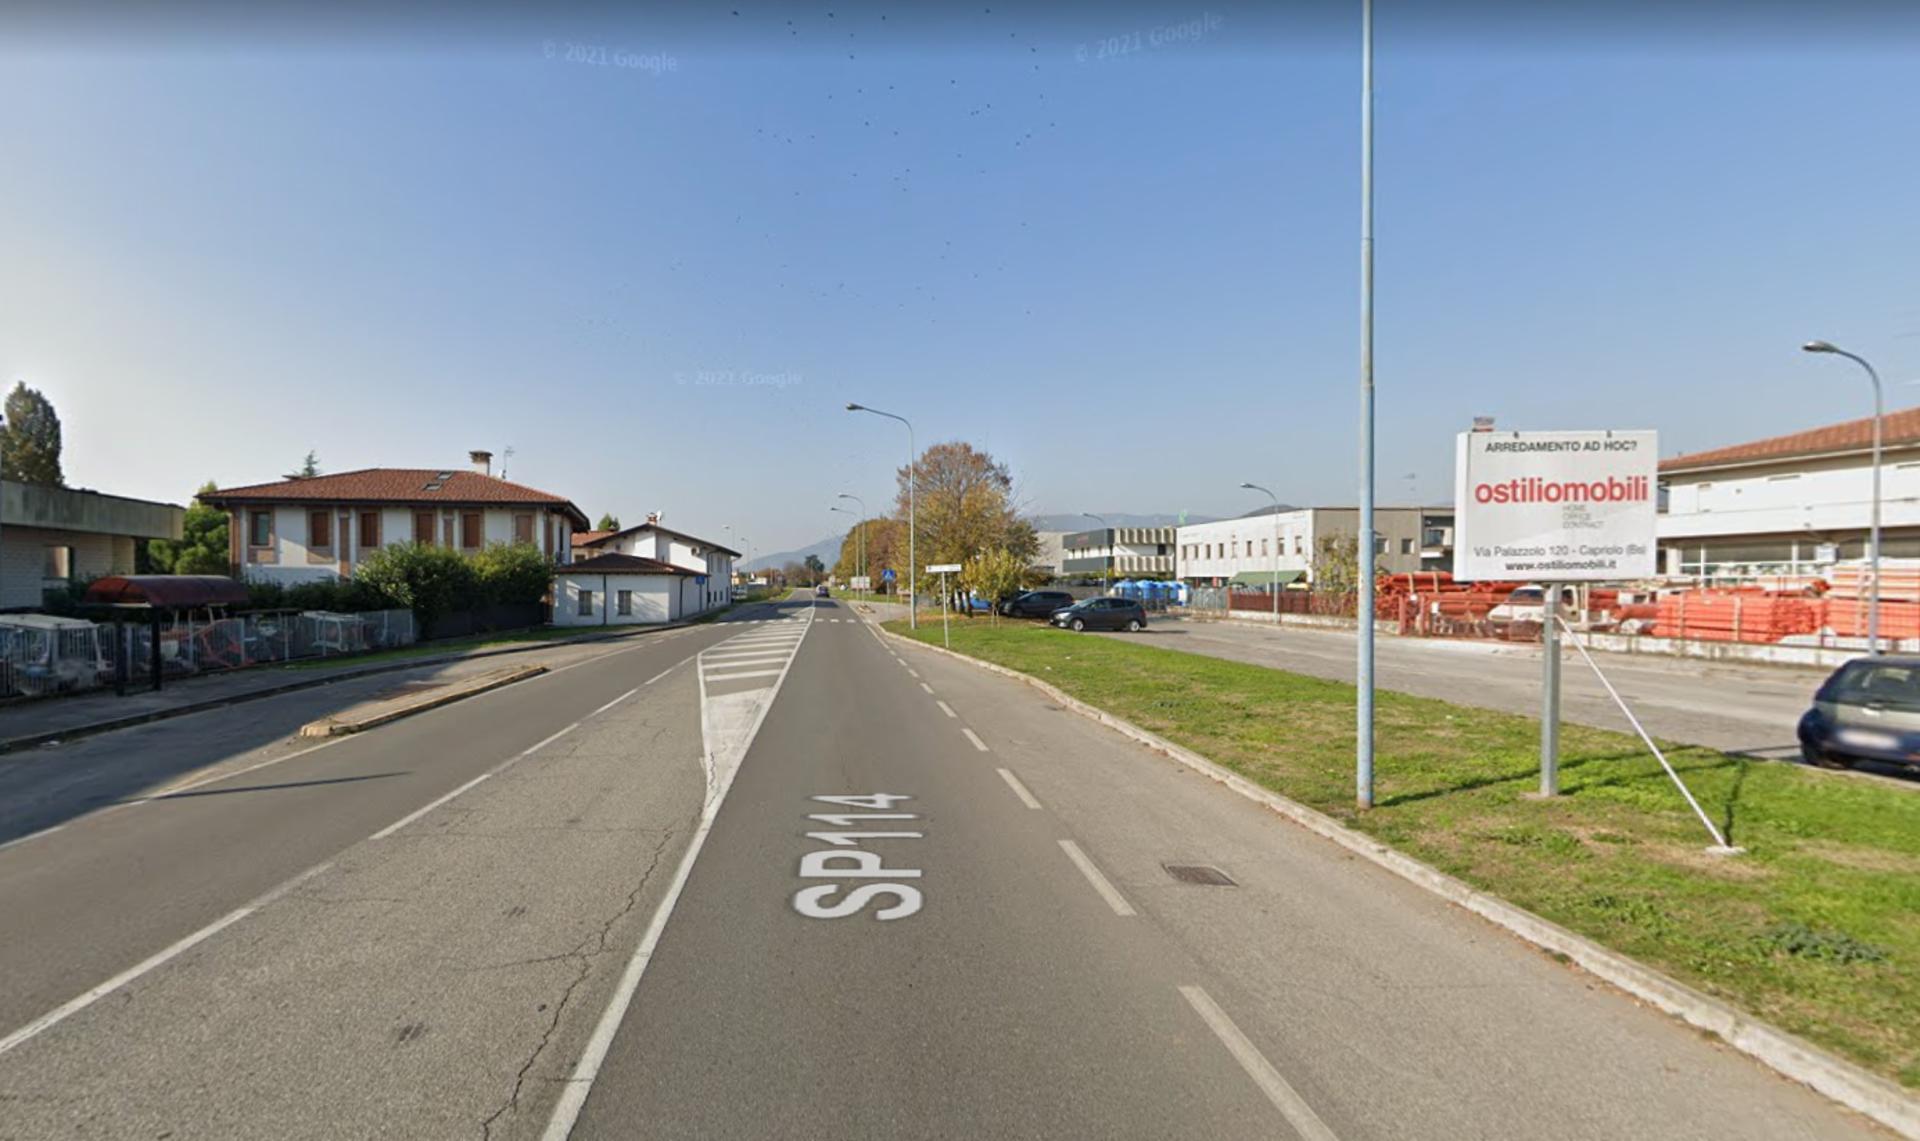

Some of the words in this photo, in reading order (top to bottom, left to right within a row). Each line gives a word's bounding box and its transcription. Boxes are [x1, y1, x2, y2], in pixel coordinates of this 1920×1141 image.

[1485, 441, 1580, 453] ARREDAMENTO
[1583, 441, 1600, 451] AD
[1604, 440, 1637, 450] HOC?
[1474, 475, 1649, 504] ostiliomobili
[1474, 547, 1491, 557] Via
[1494, 546, 1546, 557] Palazzolo
[1549, 545, 1569, 555] 120
[1505, 559, 1617, 571] www.ostiliomobili.it
[794, 793, 923, 921] SP114
